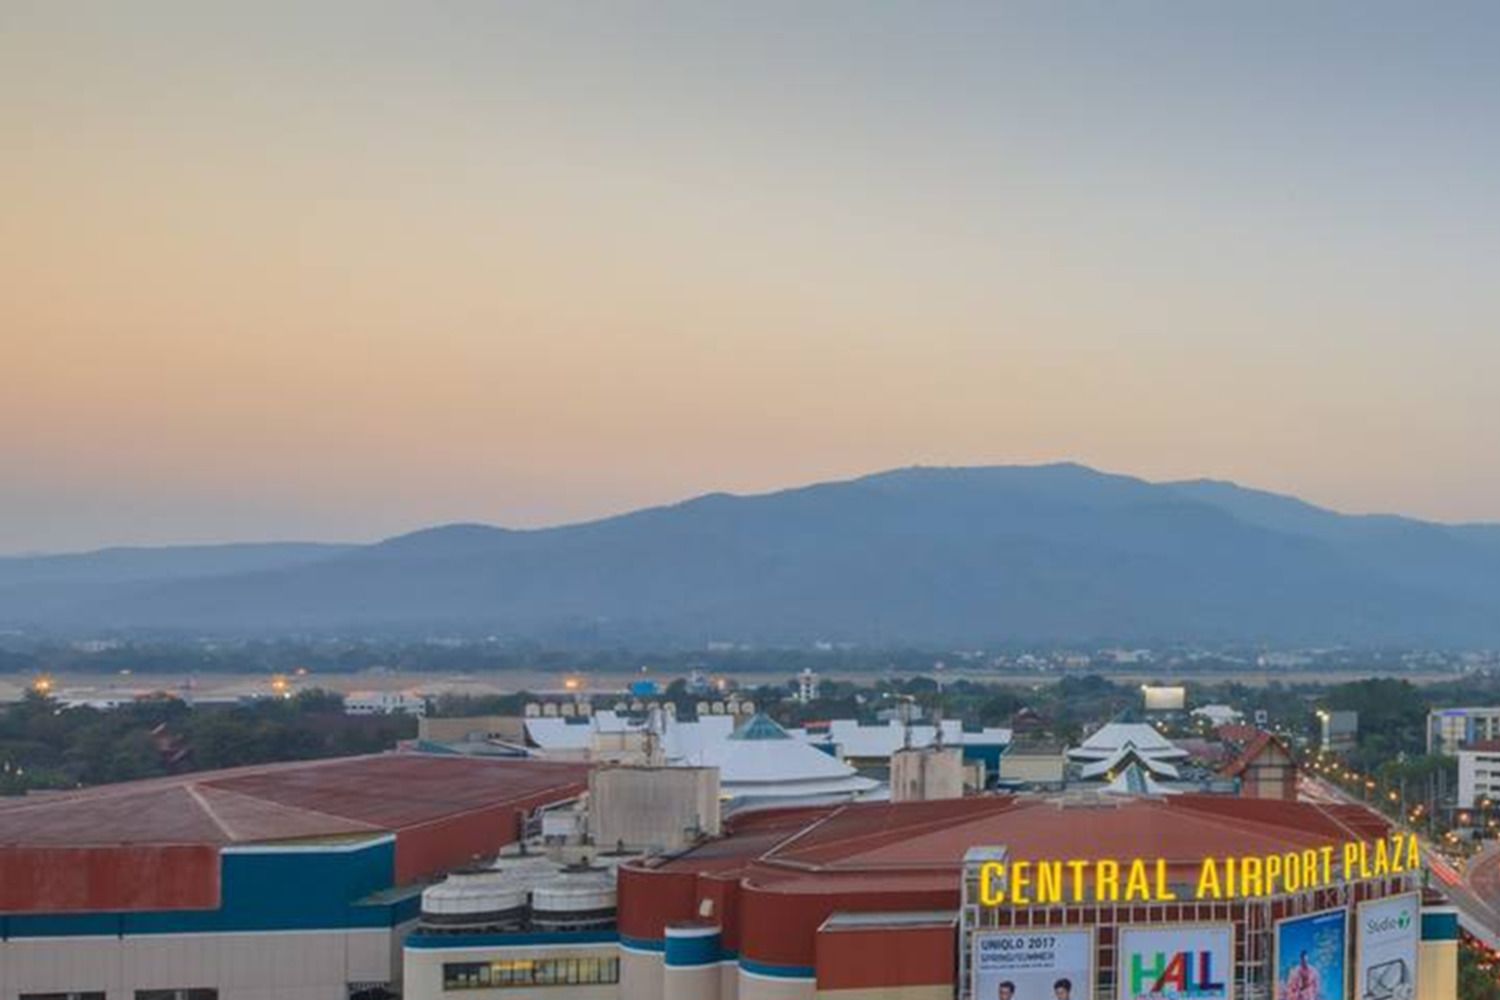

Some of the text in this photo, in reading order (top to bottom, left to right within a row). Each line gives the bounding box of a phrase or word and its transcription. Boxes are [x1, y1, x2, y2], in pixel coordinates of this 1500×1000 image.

[979, 832, 1420, 907] CENTRAL AIRPORT PLAZA
[1028, 936, 1057, 949] 2017
[1131, 950, 1225, 996] HALL
